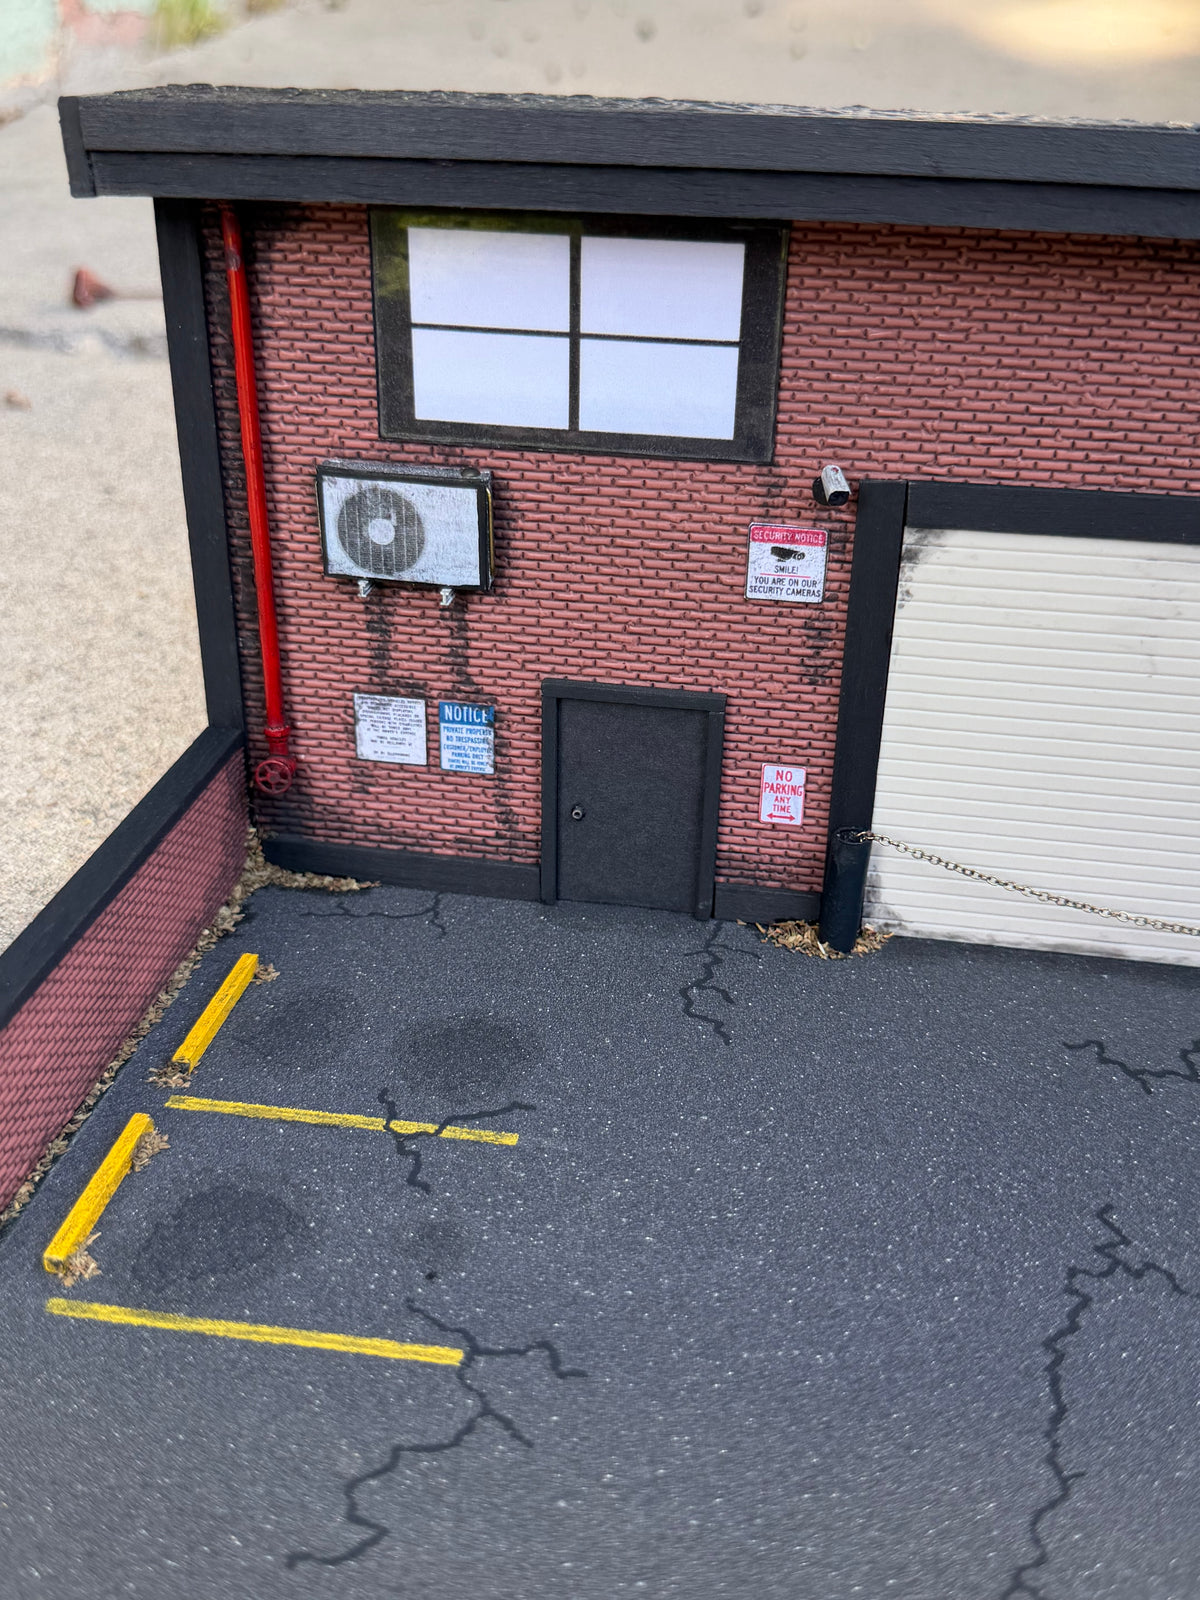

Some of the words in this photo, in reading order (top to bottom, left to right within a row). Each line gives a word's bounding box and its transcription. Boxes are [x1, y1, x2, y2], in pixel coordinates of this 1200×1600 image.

[754, 531, 793, 541] SECURITY
[795, 534, 823, 543] NOTICE
[774, 565, 798, 574] SMILE!
[755, 576, 768, 584] YOU
[772, 578, 785, 586] ARE
[802, 580, 817, 588] OUR
[749, 586, 783, 595] SECURITY
[786, 588, 821, 597] CAMERAS
[445, 705, 488, 723] NOTICE
[443, 726, 464, 734] PRIVATE
[776, 770, 792, 782] NO
[764, 782, 802, 796] PARKING
[774, 796, 791, 804] ANY
[773, 804, 791, 813] TIME
